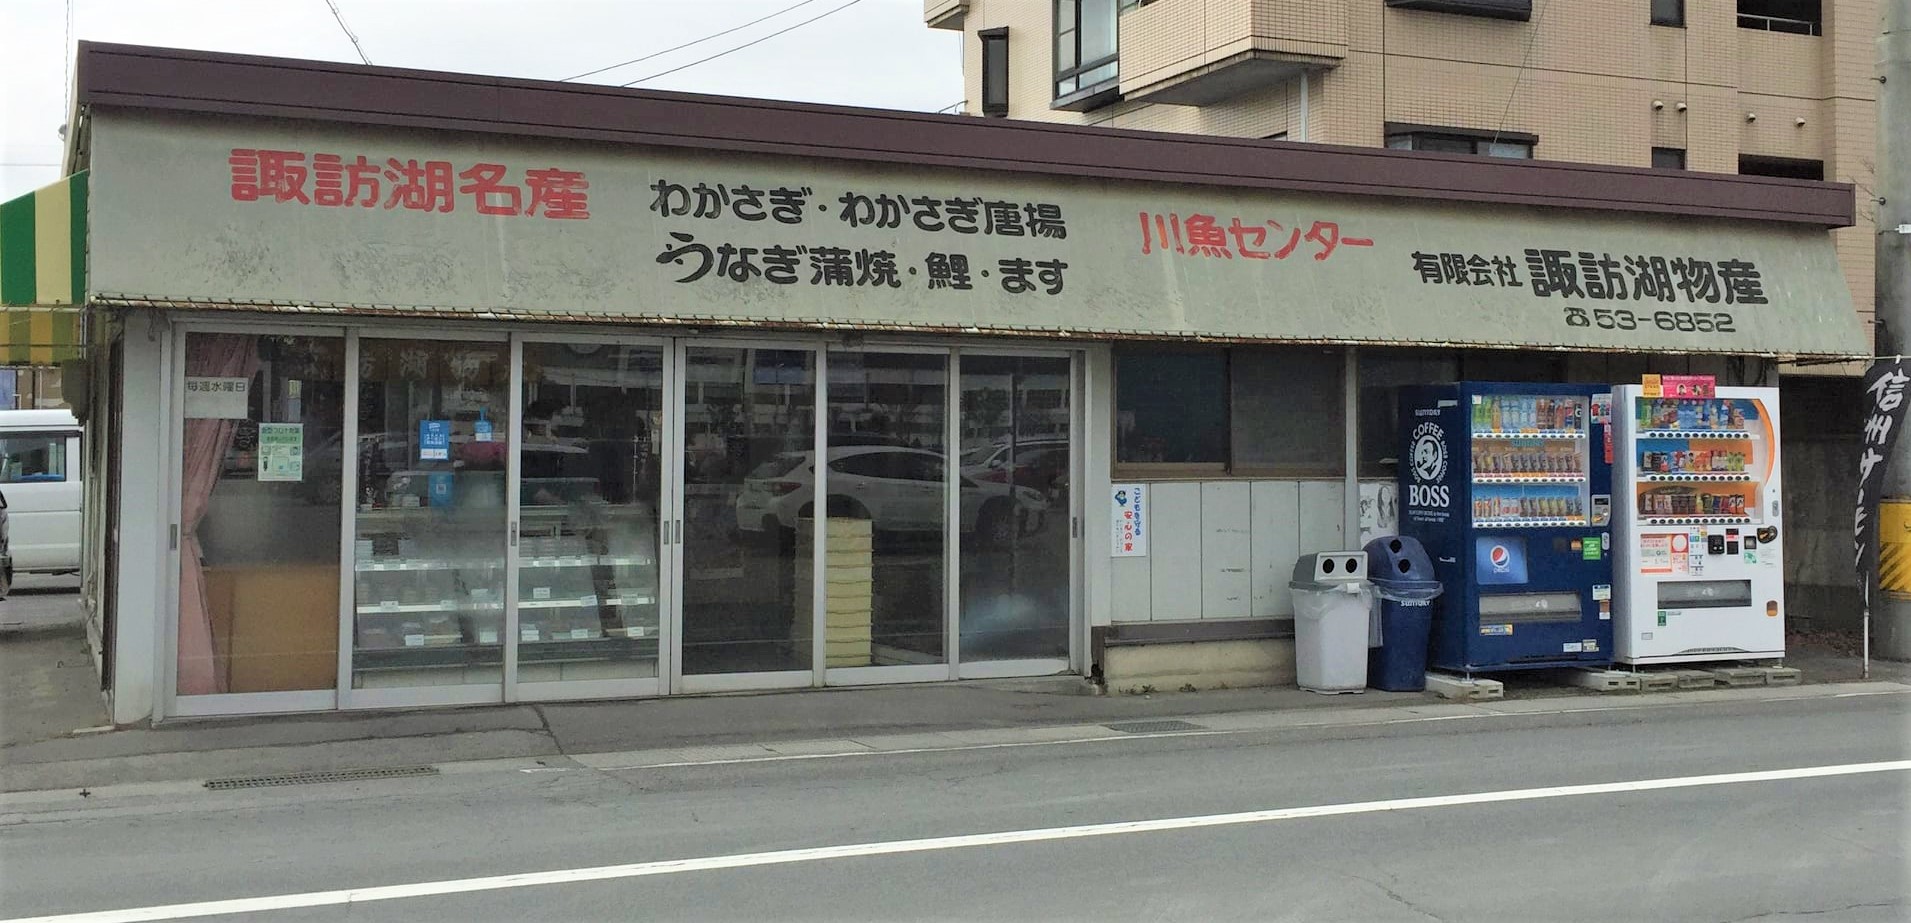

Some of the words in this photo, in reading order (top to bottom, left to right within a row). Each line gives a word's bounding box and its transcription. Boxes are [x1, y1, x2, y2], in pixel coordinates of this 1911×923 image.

[229, 148, 591, 219] 諏訪湖名産
[1139, 211, 1374, 261] 川魚センター
[1411, 250, 1523, 290] 有限会社
[1525, 247, 1768, 305] 諏訪湖物産
[188, 381, 246, 392] 毎週水曜日
[1413, 422, 1445, 441] COFFEE
[1408, 484, 1450, 508] BOSS
[1123, 510, 1133, 551] 安心の家
